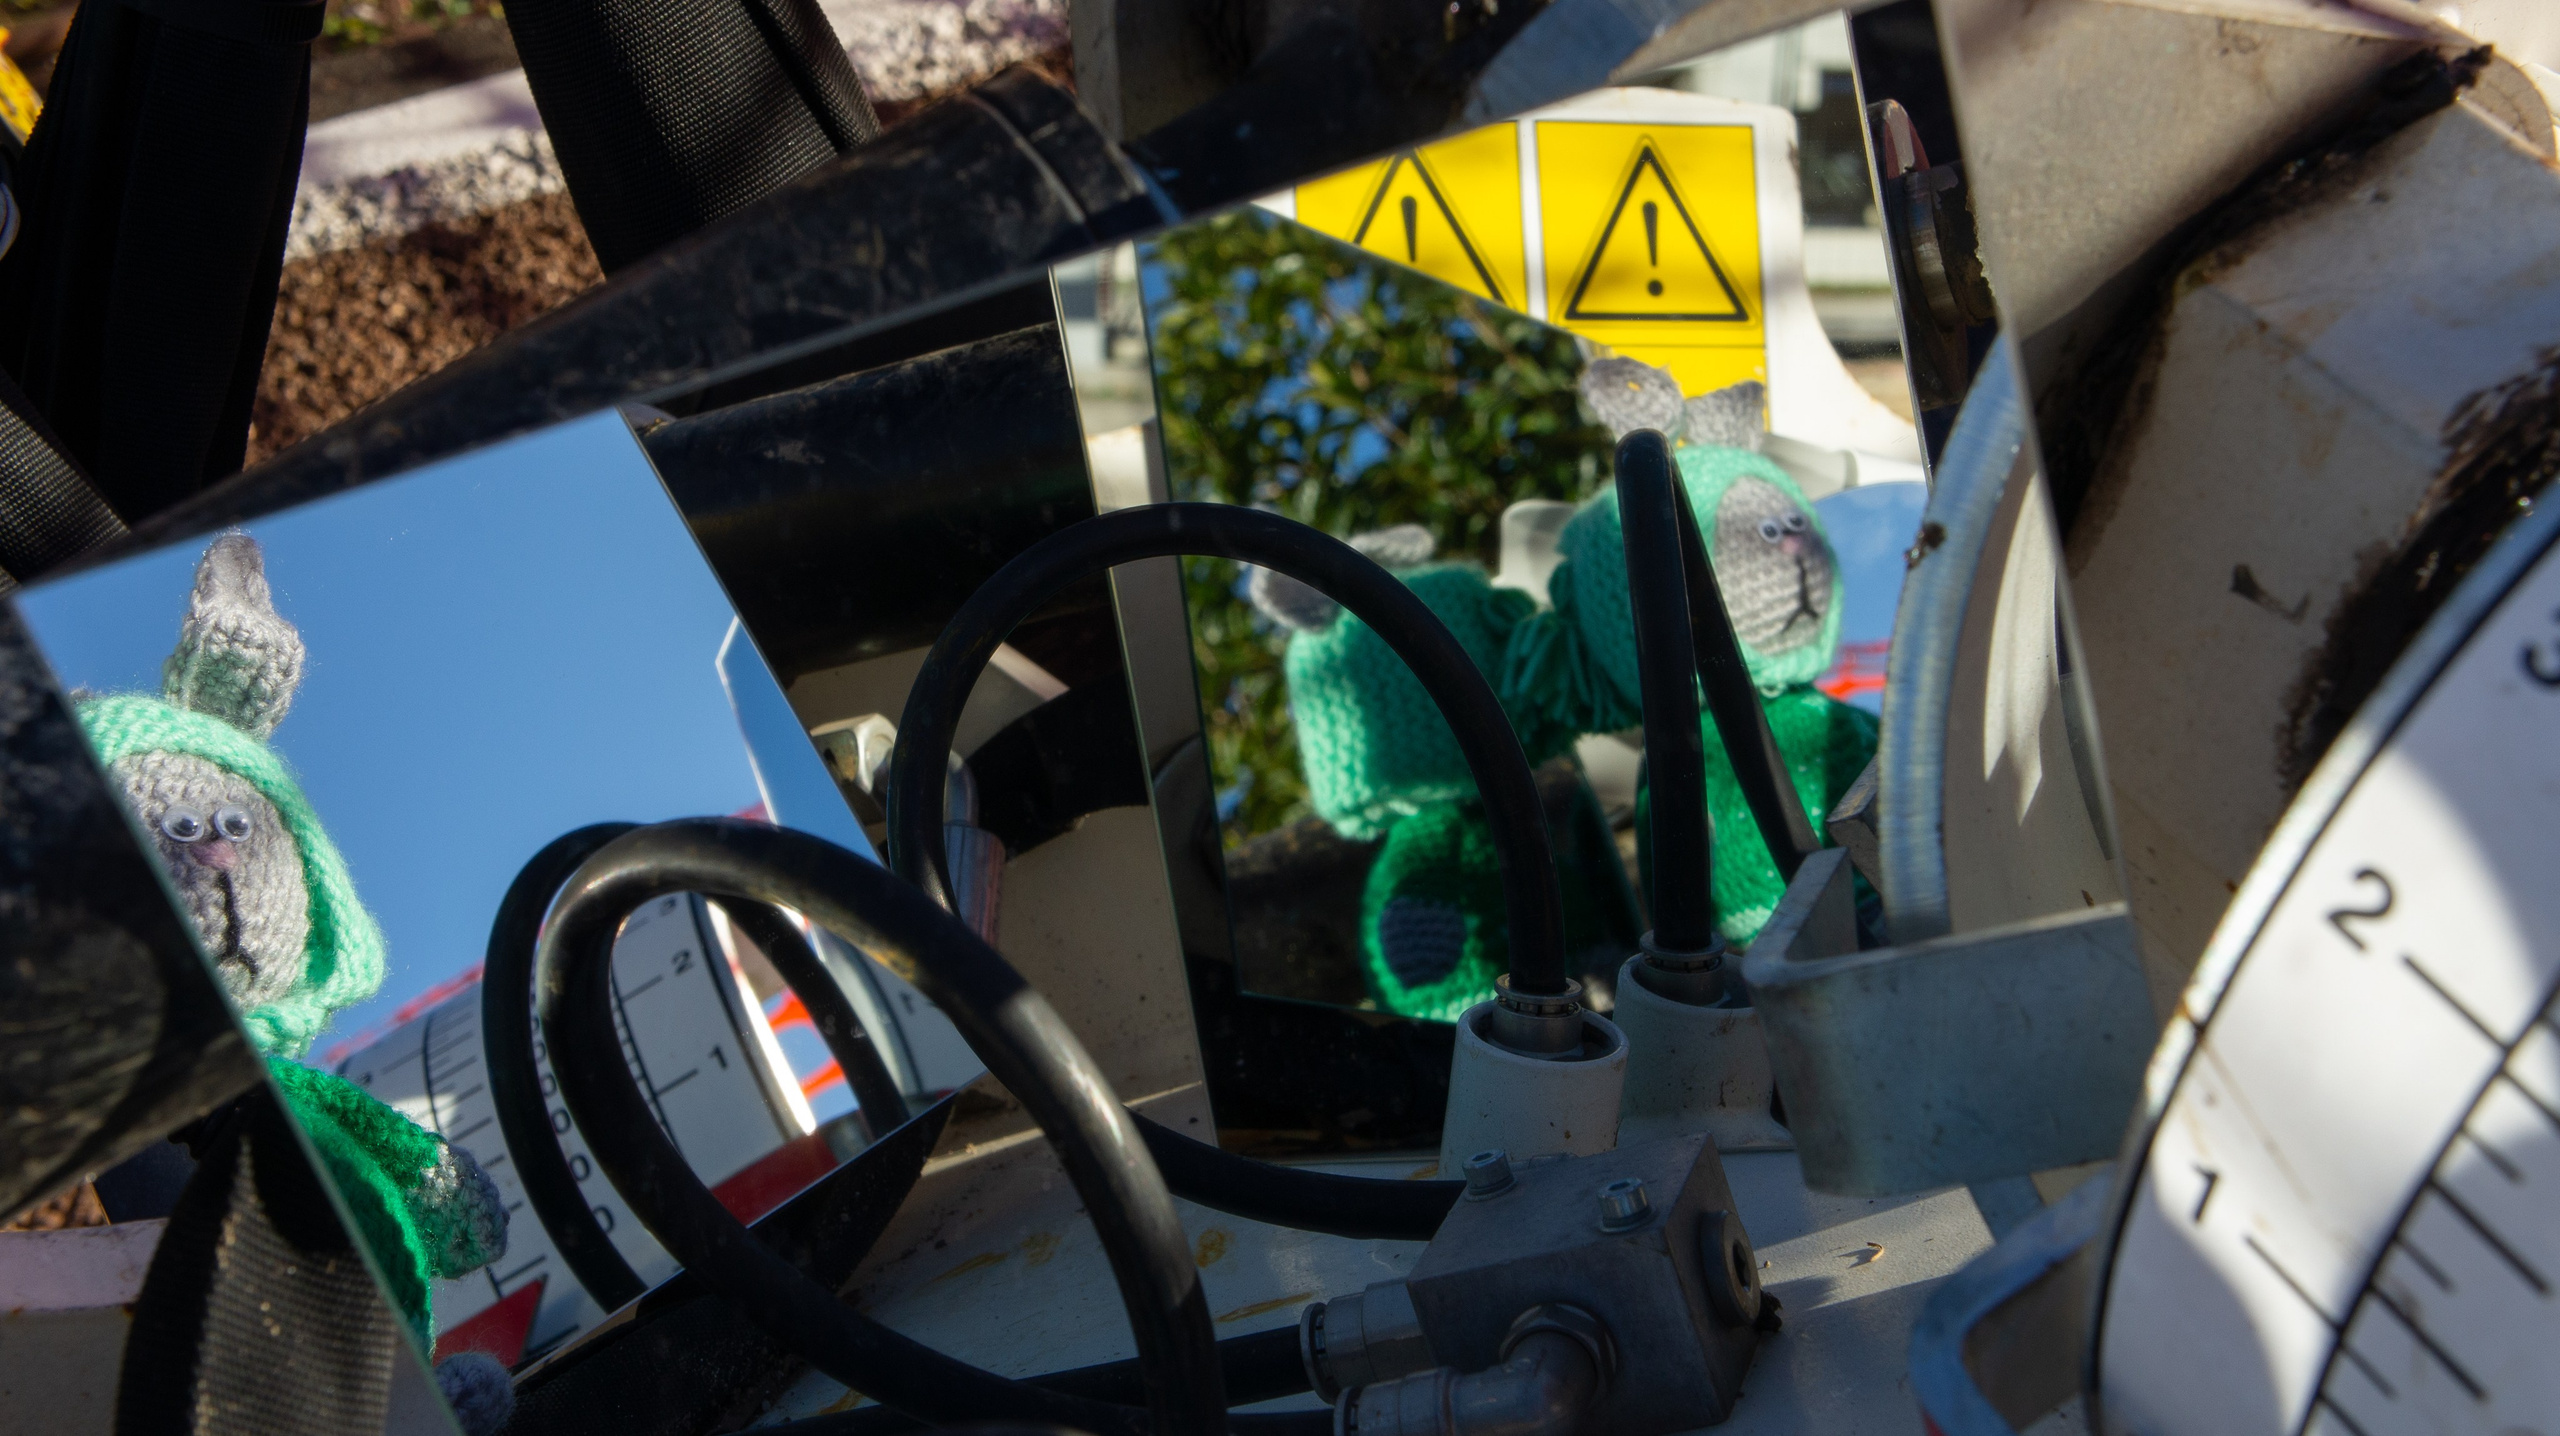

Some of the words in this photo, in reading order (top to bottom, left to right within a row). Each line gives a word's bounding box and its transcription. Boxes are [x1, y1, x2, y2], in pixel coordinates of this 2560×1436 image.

[2326, 865, 2396, 955] 2
[671, 950, 694, 977] 2
[708, 1045, 728, 1070] 1
[2190, 1162, 2220, 1222] 1
